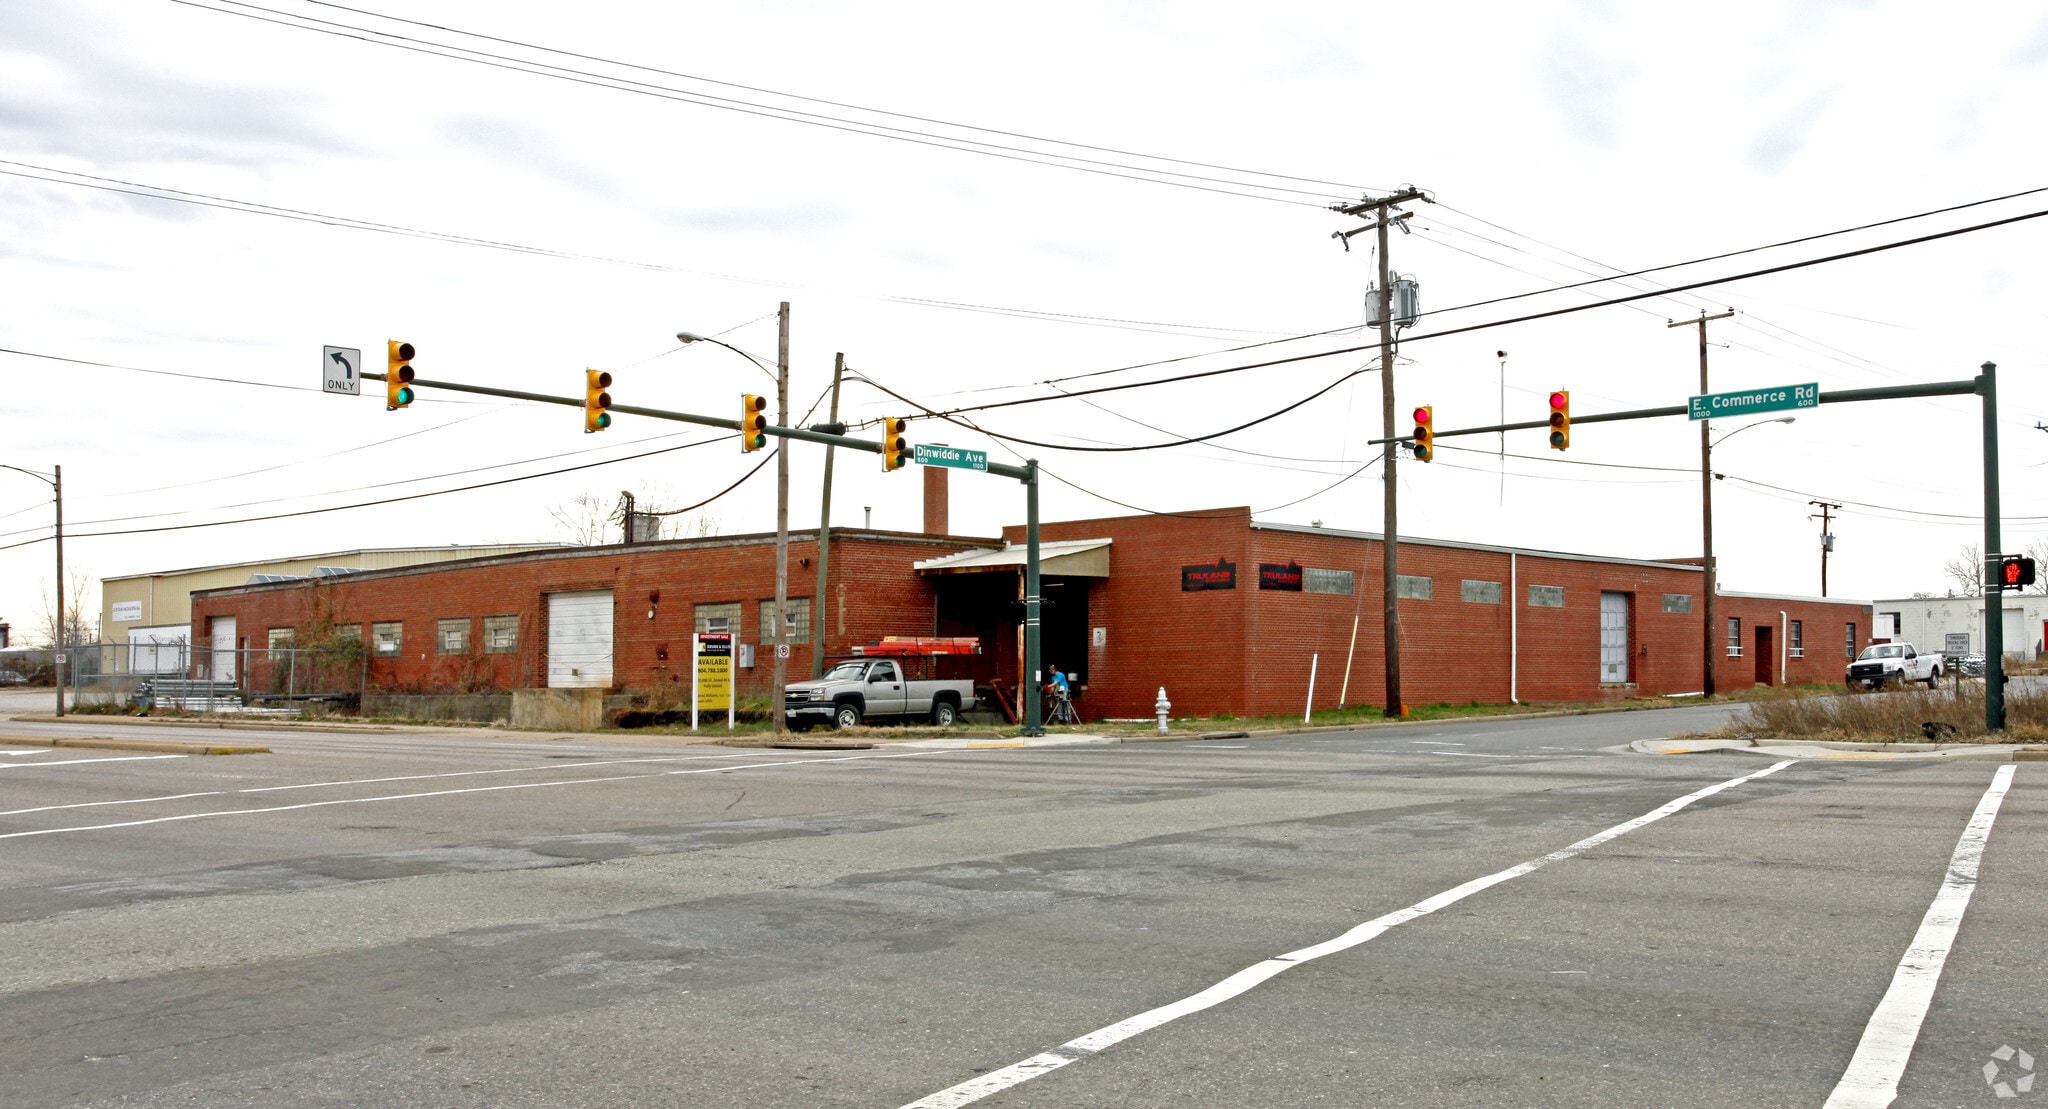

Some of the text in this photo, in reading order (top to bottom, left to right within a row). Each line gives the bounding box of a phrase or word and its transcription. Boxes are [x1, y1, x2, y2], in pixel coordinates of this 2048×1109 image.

[328, 379, 355, 390] ONLY
[1693, 386, 1814, 411] E. Commerce Rd
[1797, 399, 1814, 407] 600
[1693, 410, 1711, 418] 1000
[917, 446, 984, 464] Dinwiddie Ave
[1187, 571, 1231, 580] TRULAND
[1263, 571, 1300, 580] TRULAND
